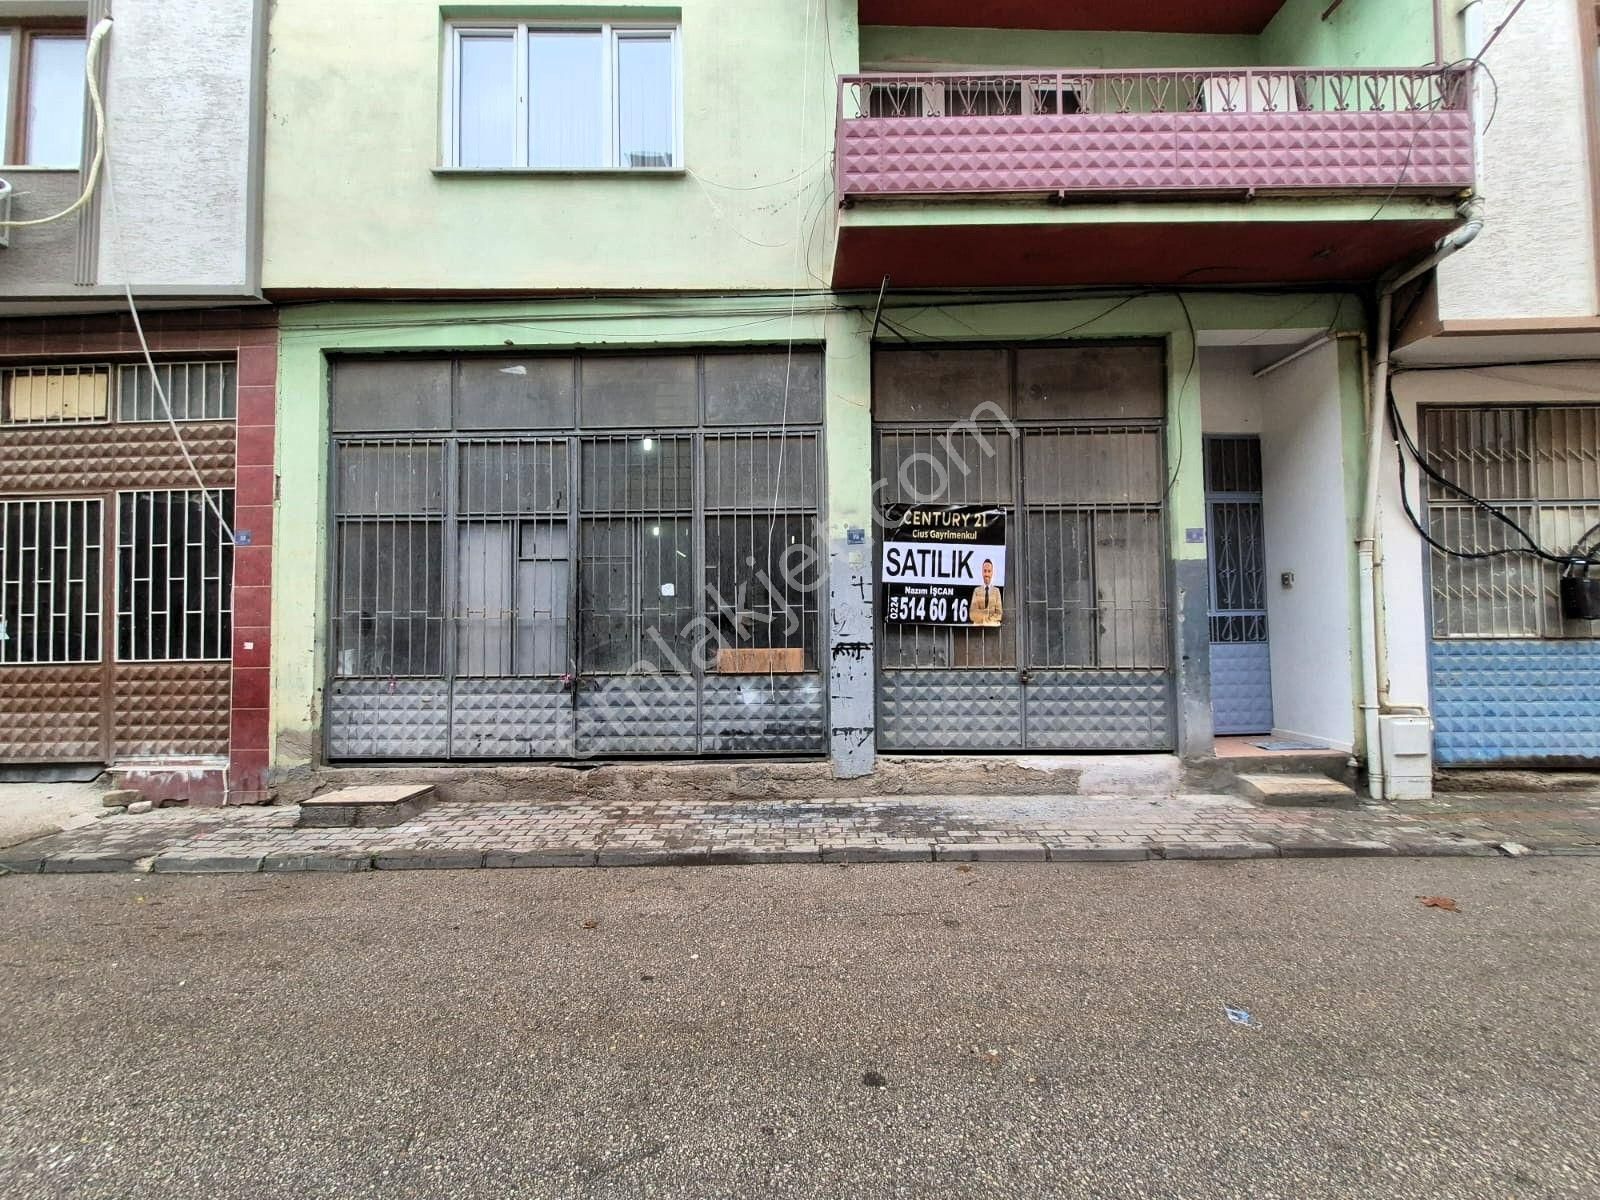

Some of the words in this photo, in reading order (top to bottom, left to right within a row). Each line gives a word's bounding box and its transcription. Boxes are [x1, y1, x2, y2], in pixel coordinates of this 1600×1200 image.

[903, 510, 970, 527] CENTURY
[974, 512, 987, 527] 21
[930, 530, 978, 540] Gayrimenkul
[886, 548, 975, 579] SATILIK
[904, 586, 928, 595] Nazım
[929, 585, 954, 597] İŞCAN
[890, 596, 899, 620] 0224
[899, 596, 926, 620] 514
[929, 597, 947, 621] 60
[951, 598, 969, 622] 16
